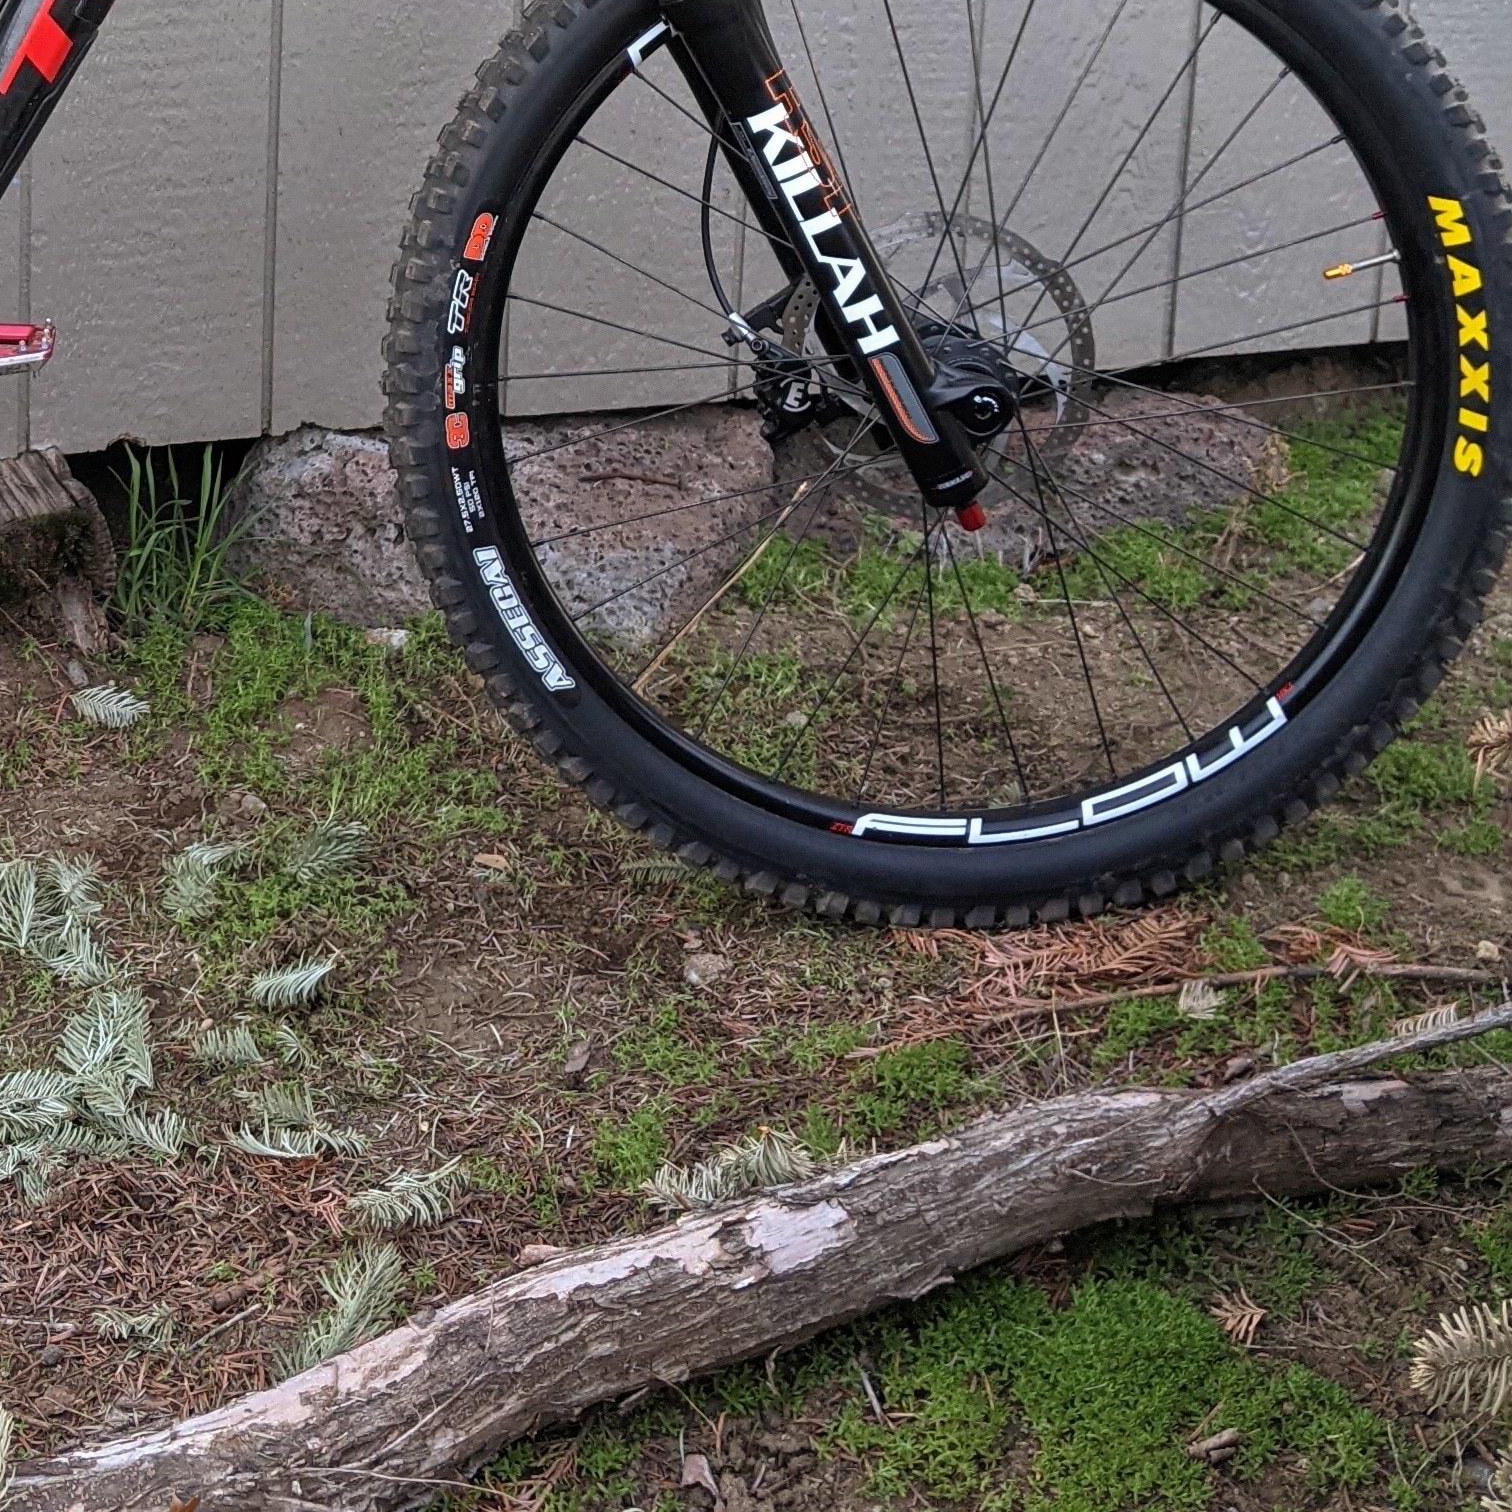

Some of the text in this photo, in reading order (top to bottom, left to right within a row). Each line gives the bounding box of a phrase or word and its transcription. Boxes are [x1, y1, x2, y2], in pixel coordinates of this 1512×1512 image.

[447, 269, 474, 335] TR
[747, 102, 900, 356] KILLAH
[1428, 194, 1490, 478] MAXXIS
[445, 411, 471, 449] 3C
[472, 545, 576, 692] ASSEGAI
[851, 696, 1287, 844] FLOW
